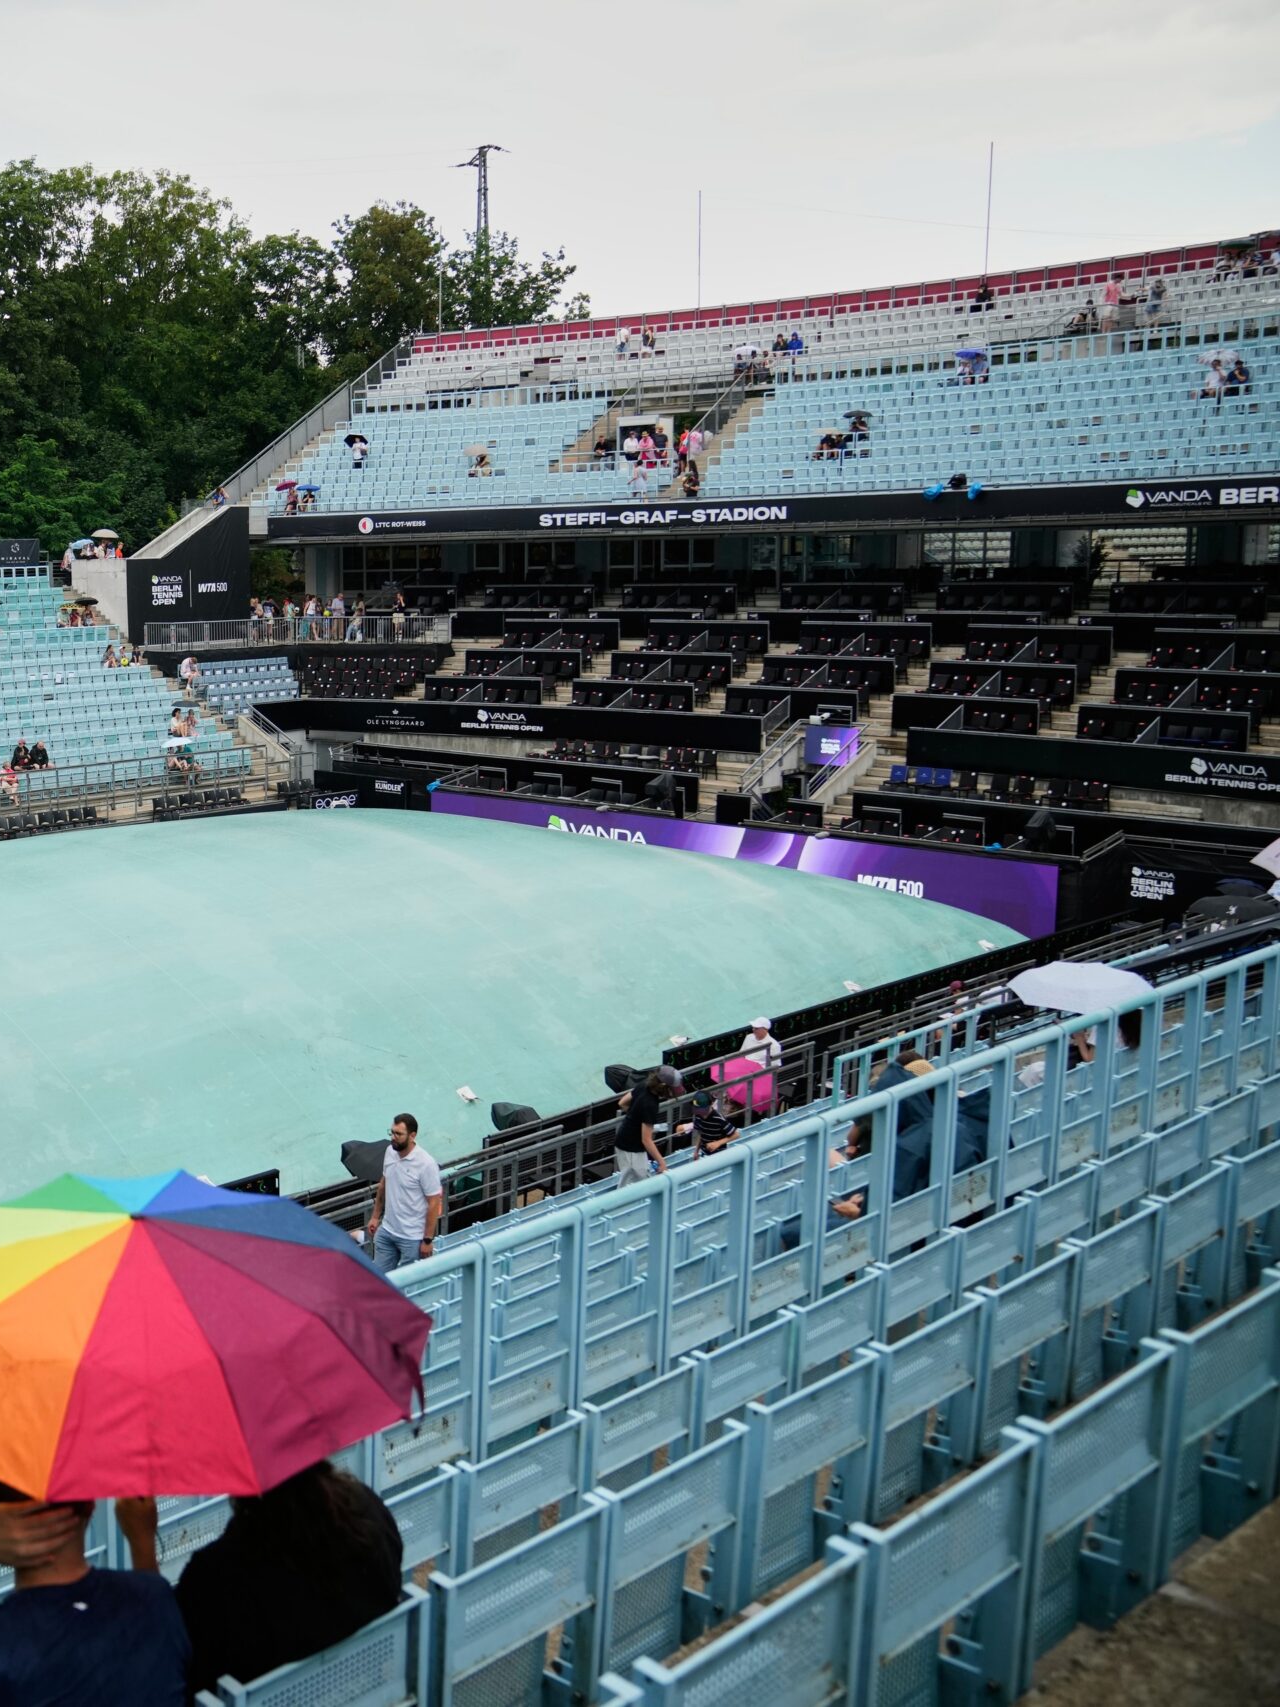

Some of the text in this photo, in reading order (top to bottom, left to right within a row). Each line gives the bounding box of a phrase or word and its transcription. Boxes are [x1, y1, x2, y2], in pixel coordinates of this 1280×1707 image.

[1145, 489, 1212, 503] VANDA
[391, 520, 426, 528] ROT-WEISS
[151, 584, 182, 592] BERLIN
[198, 582, 228, 593] WTA 500
[151, 591, 183, 599] TENNIS
[152, 598, 176, 606] OPEN
[488, 711, 527, 721] VANDA
[461, 721, 489, 729] BERLIN
[489, 723, 520, 731] TENNIS
[1208, 762, 1268, 777] VANDA
[1164, 773, 1208, 785] BERLIN
[1210, 778, 1256, 789] TENNIS
[569, 822, 647, 845] VANDA
[1141, 869, 1176, 879] VANDA
[1131, 877, 1173, 888] BERLIN
[898, 879, 924, 899] 500
[1130, 884, 1175, 895] TENNIS
[1130, 890, 1163, 900] OPEN
